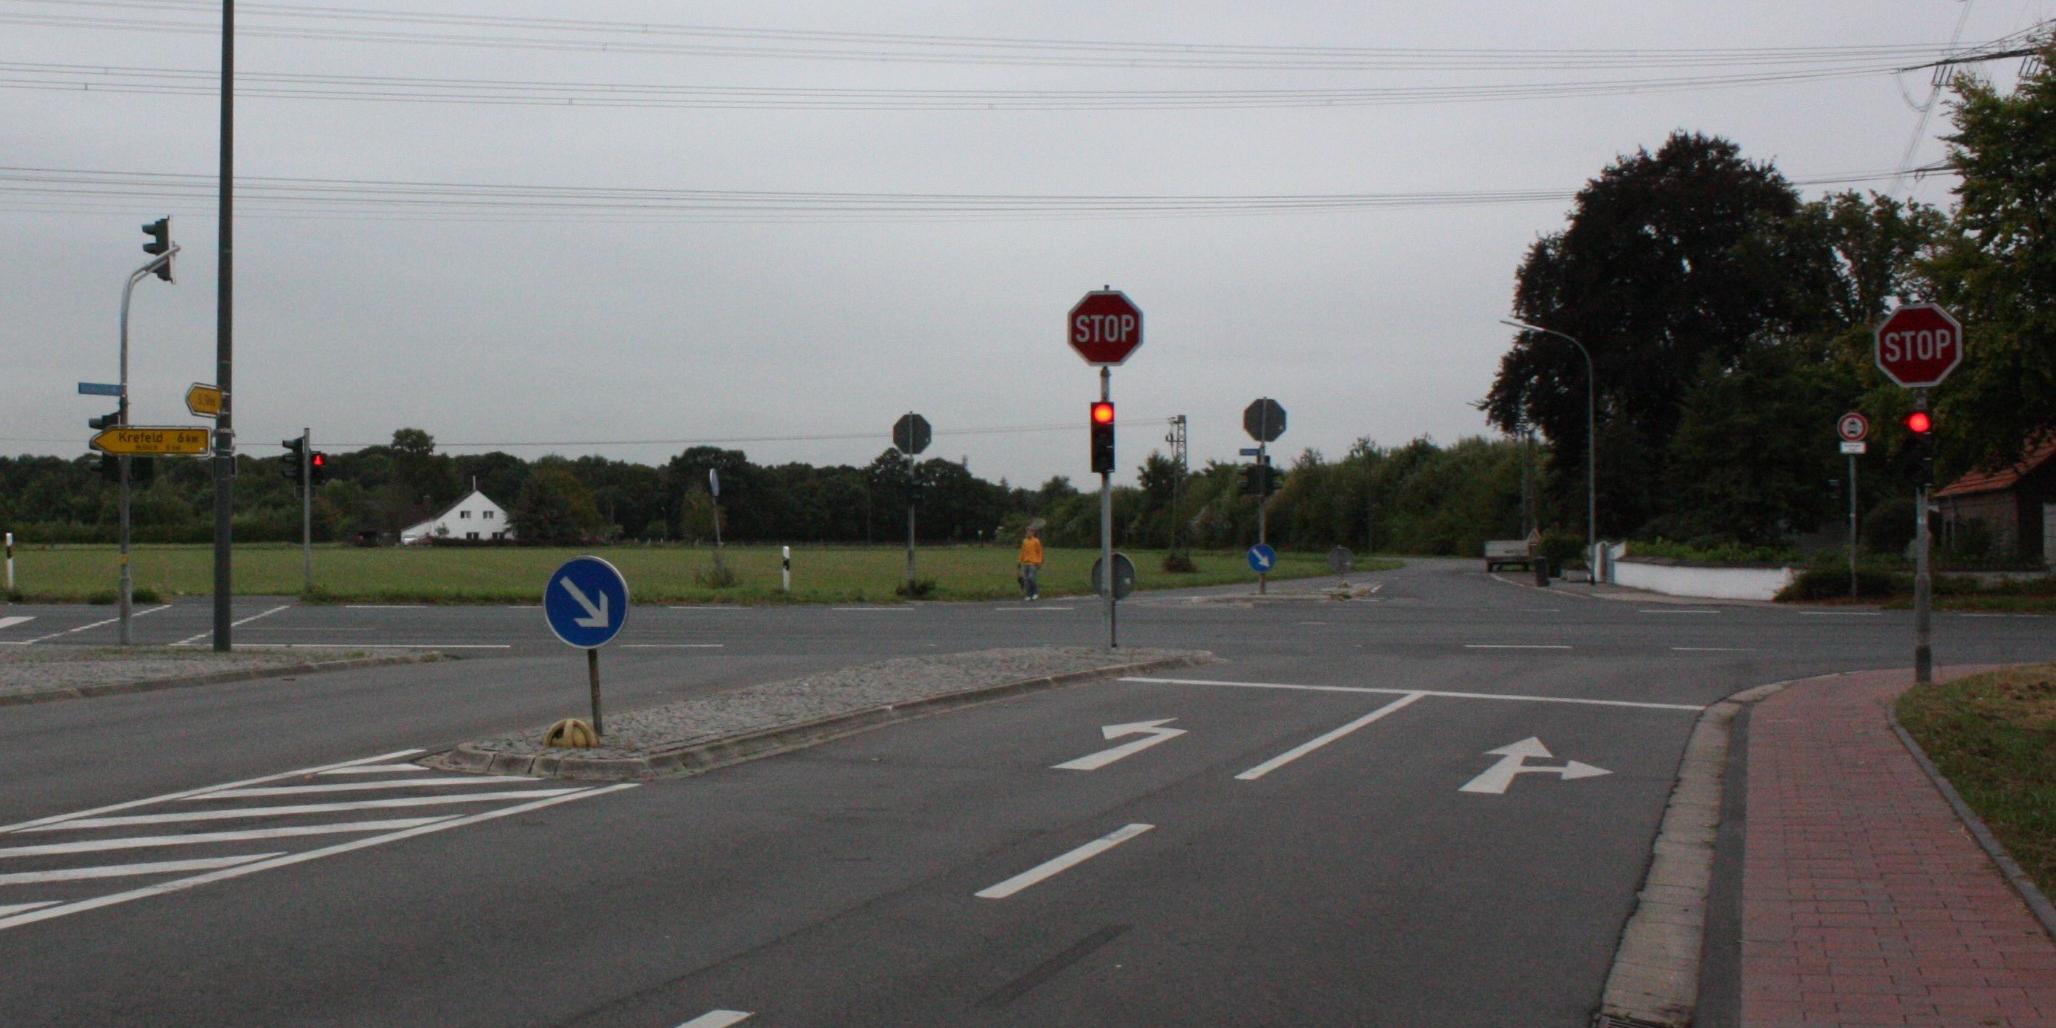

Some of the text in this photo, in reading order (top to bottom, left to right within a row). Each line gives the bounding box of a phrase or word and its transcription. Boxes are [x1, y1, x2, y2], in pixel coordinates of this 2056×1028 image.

[1076, 314, 1134, 342] STOP
[1885, 329, 1951, 362] STOP
[118, 432, 163, 443] Krefeld
